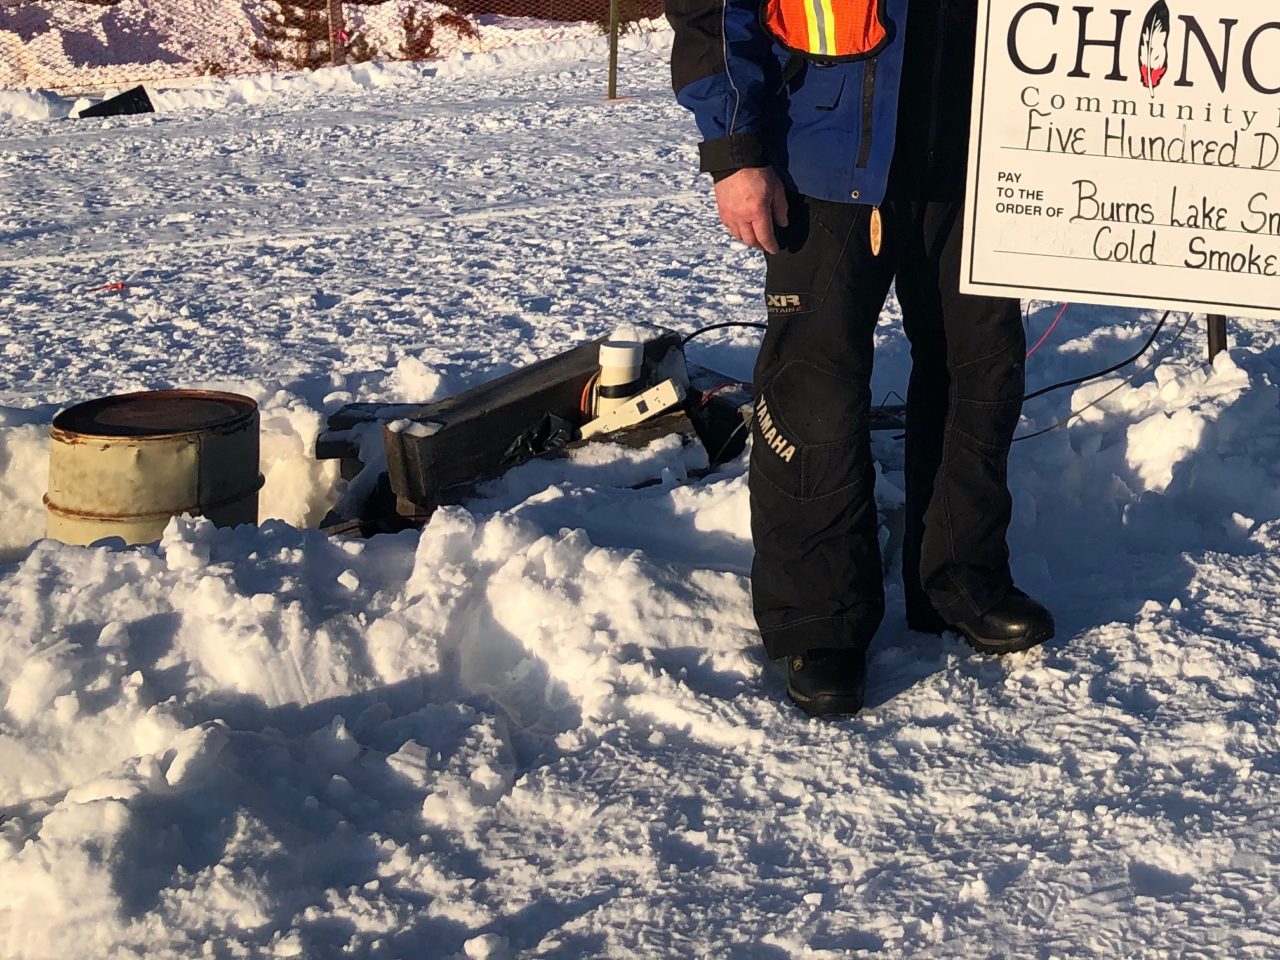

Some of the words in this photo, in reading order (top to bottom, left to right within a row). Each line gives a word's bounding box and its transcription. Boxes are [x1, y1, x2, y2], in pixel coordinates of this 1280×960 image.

[1020, 85, 1258, 131] Community
[1026, 108, 1087, 155] Five
[1104, 117, 1239, 167] Hundred
[996, 187, 1015, 199] TO
[1018, 188, 1044, 201] THE
[998, 172, 1022, 184] PAY
[995, 202, 1043, 216] ORDER
[1045, 205, 1064, 218] OF
[1069, 179, 1155, 224] Burns
[1170, 186, 1228, 231] Lake
[1093, 226, 1156, 265] Cold
[1184, 236, 1277, 276] Smoke
[766, 294, 801, 307] XR
[756, 393, 796, 463] YAMAHA
